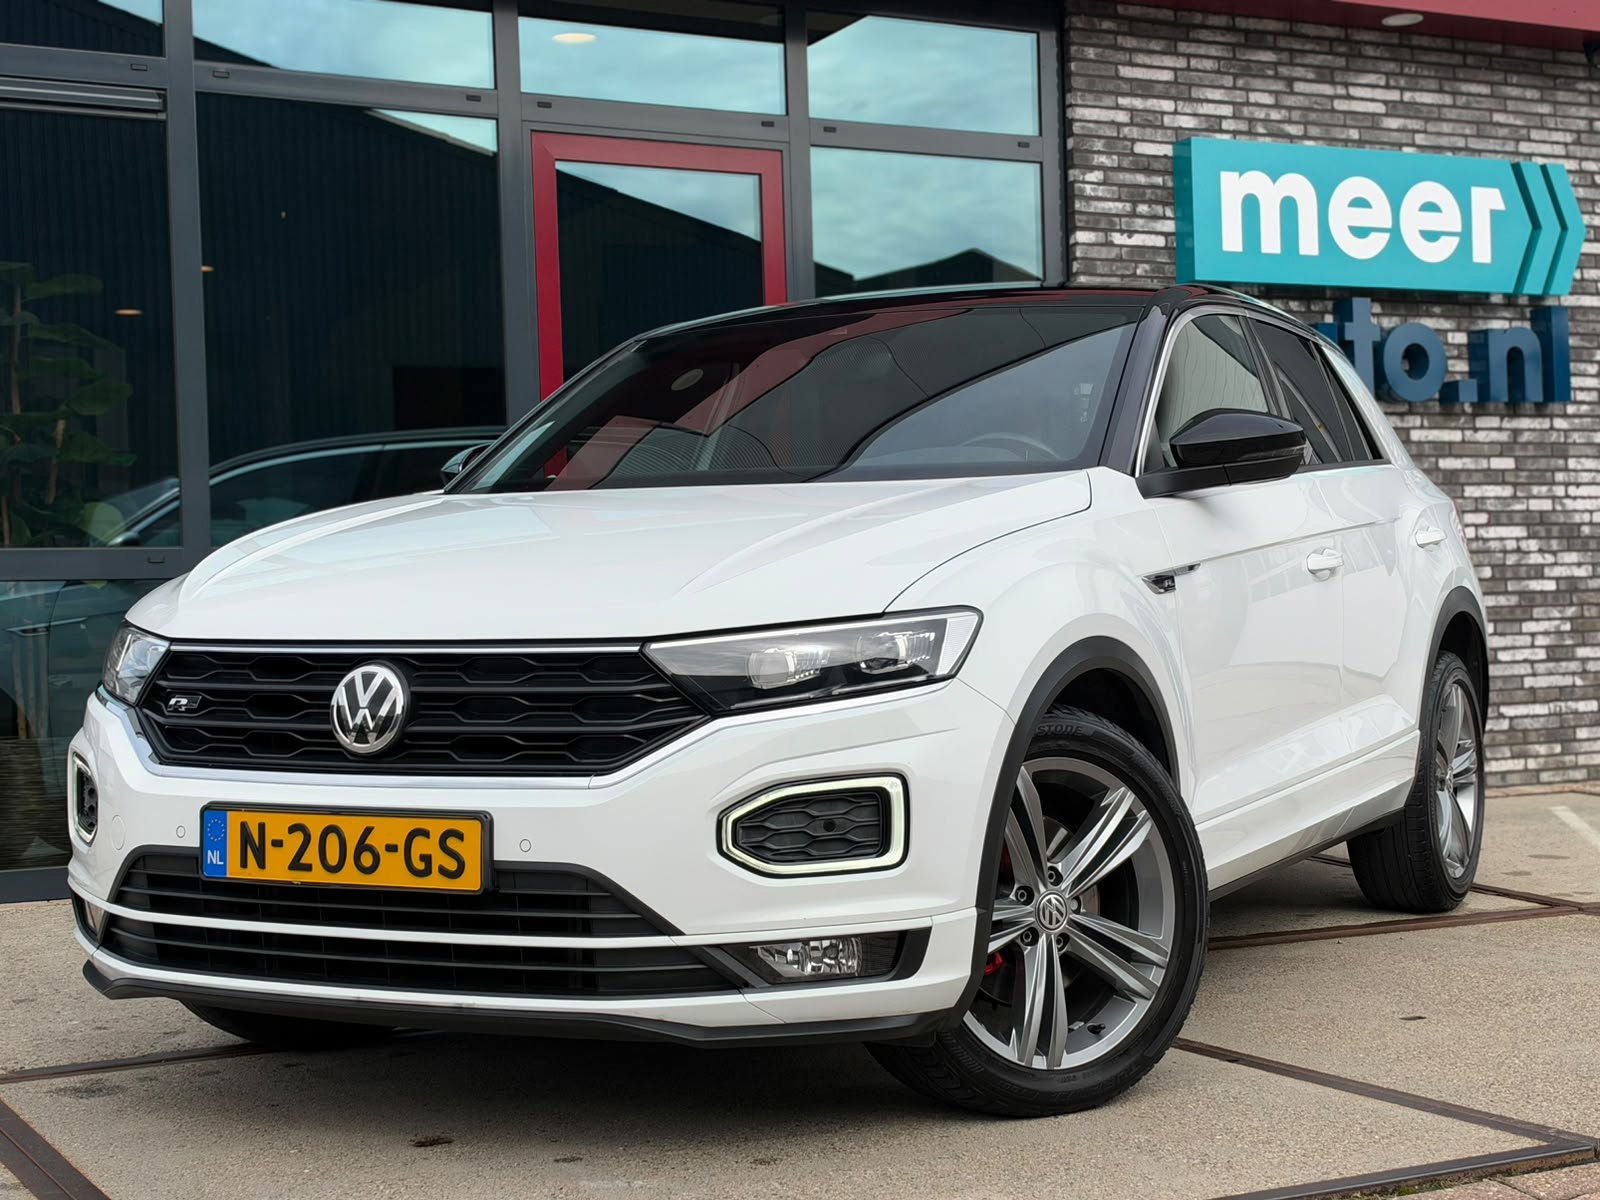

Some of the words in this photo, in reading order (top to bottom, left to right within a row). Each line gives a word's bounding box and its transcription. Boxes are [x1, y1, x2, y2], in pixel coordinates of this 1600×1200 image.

[1219, 170, 1506, 264] meer
[1317, 297, 1572, 403] to.nl
[332, 666, 405, 753] VW
[207, 849, 224, 865] NL
[239, 820, 466, 880] N-206-GS
